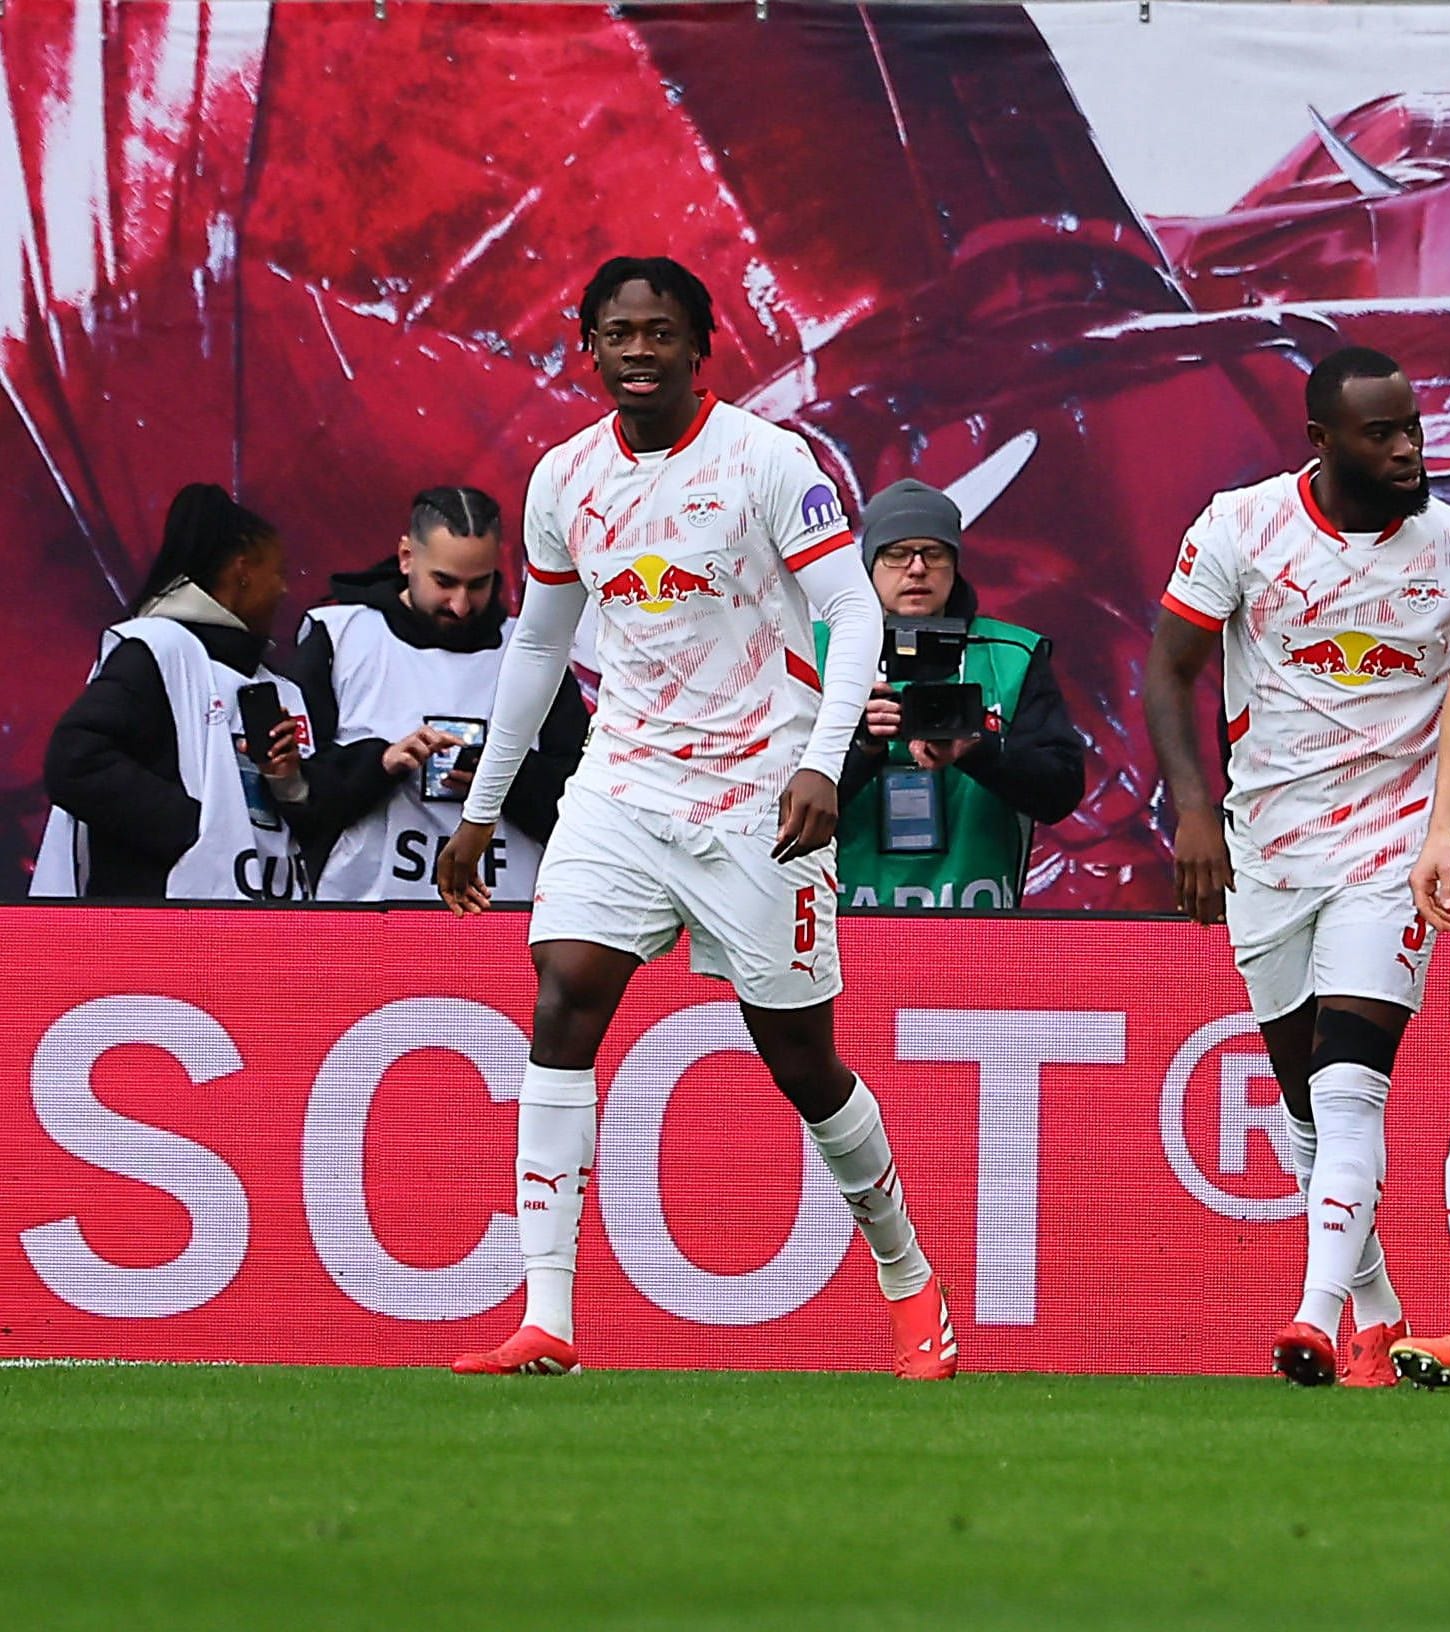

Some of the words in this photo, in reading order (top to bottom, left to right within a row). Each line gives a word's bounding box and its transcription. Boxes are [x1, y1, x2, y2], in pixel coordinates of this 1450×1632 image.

[234, 848, 309, 900] CU
[392, 829, 507, 888] SF
[795, 886, 816, 953] 5
[523, 1199, 549, 1211] RBL
[1323, 1222, 1346, 1233] RBL
